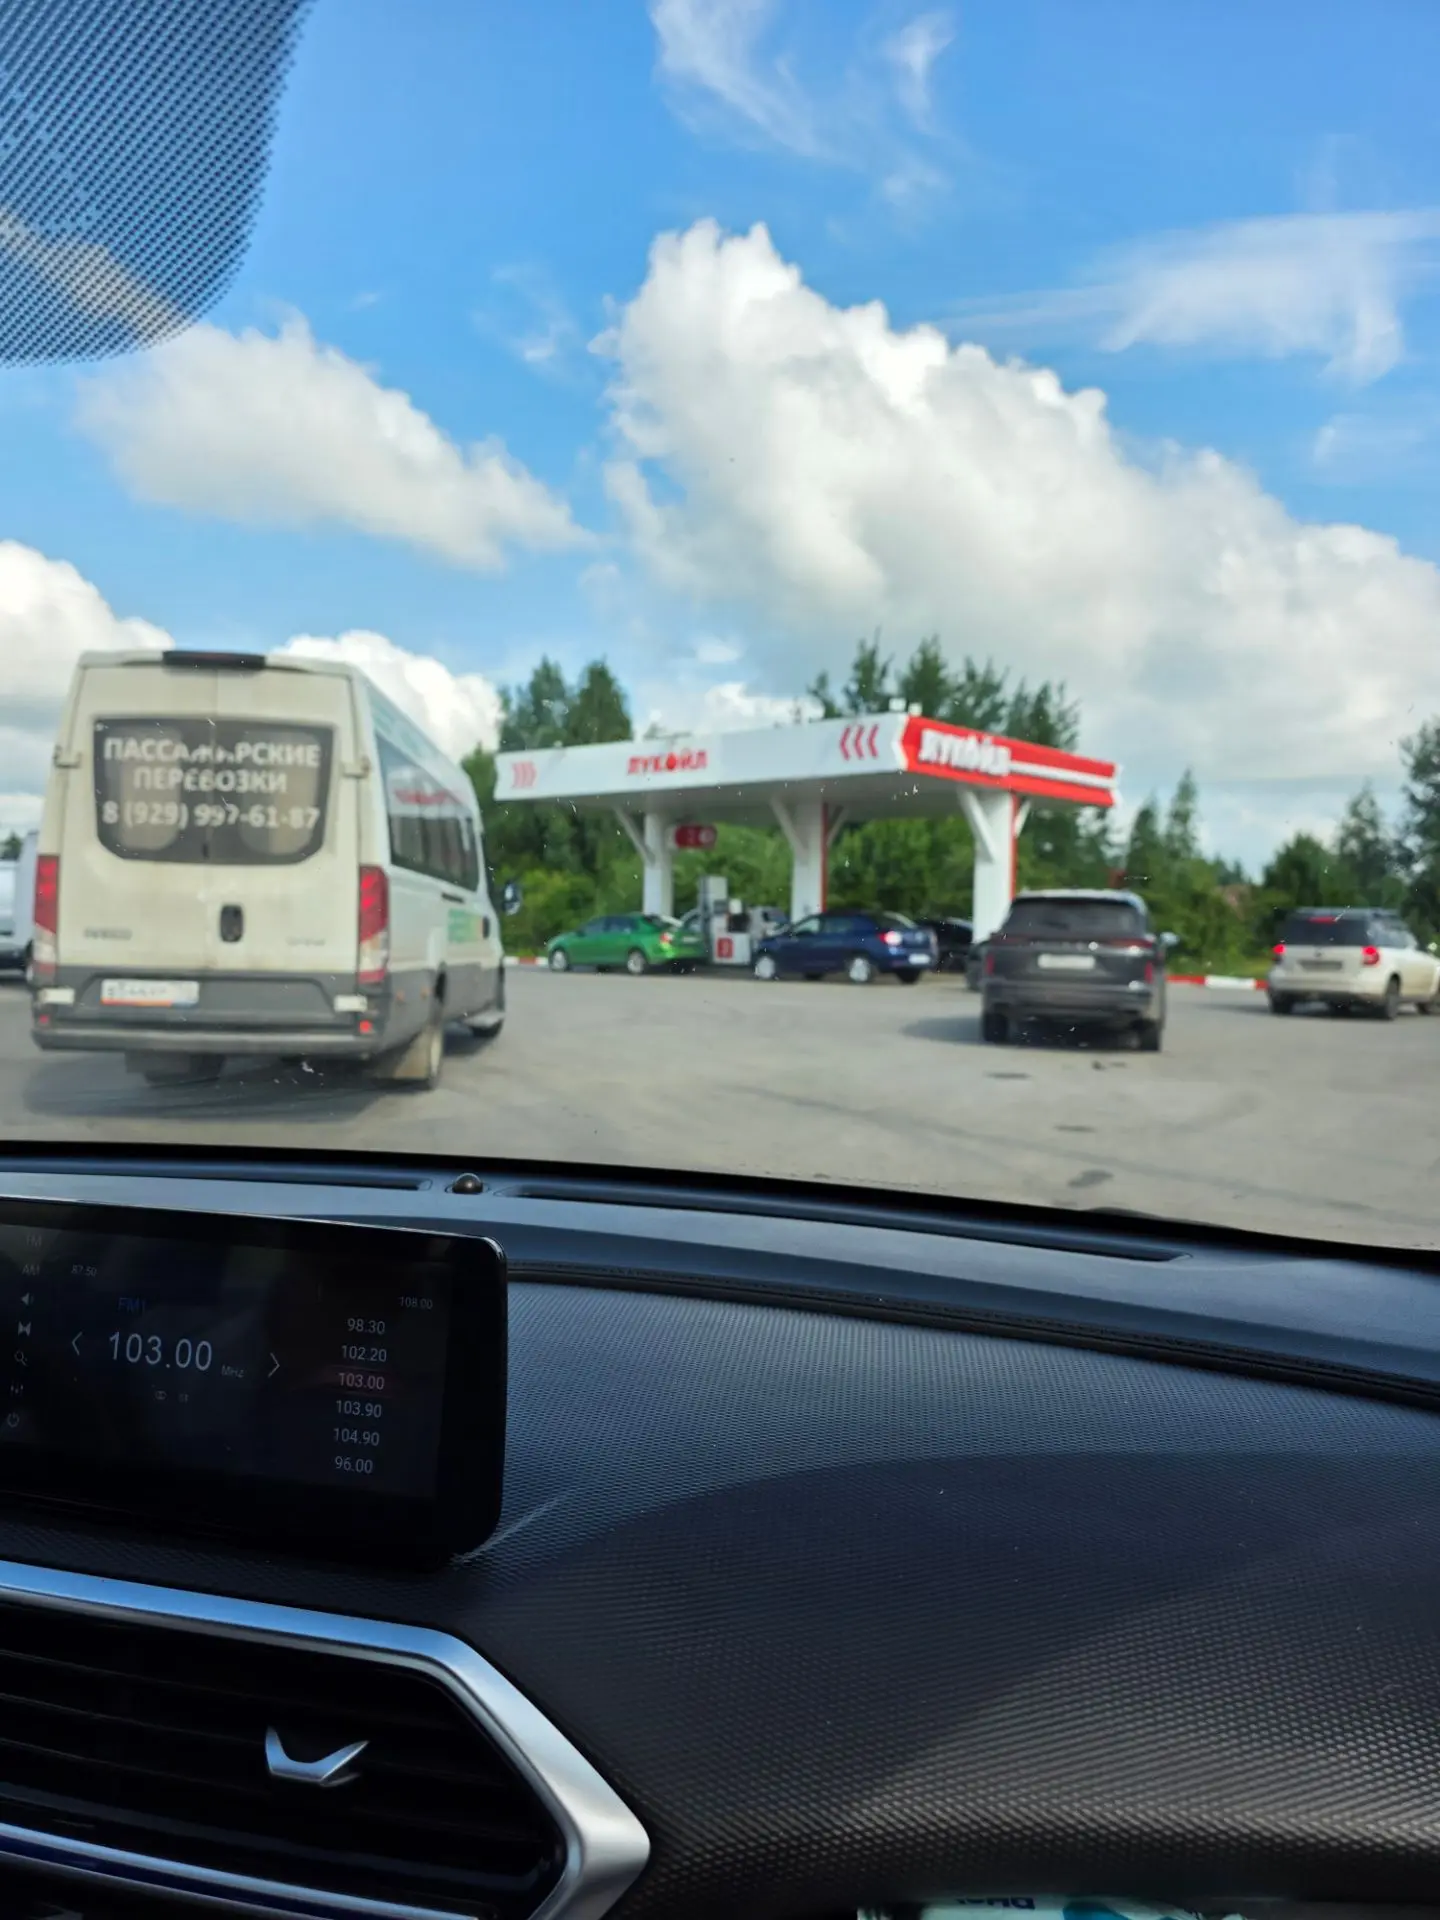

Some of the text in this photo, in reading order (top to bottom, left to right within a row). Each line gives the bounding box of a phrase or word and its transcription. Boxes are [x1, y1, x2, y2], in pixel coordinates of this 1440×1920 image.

[133, 766, 288, 794] ПЕРЕВОЗКИ
[102, 800, 119, 825] 8
[125, 800, 189, 830] (929)
[71, 1264, 98, 1278] 87.50
[398, 1296, 434, 1311] 108.00
[346, 1317, 386, 1336] 98.30
[109, 1331, 213, 1372] 103.00
[341, 1345, 388, 1363] 102.20
[339, 1372, 386, 1391] 103.00
[335, 1400, 383, 1418] 103.90
[333, 1428, 381, 1447] 104.90
[334, 1456, 374, 1475] 96.00
